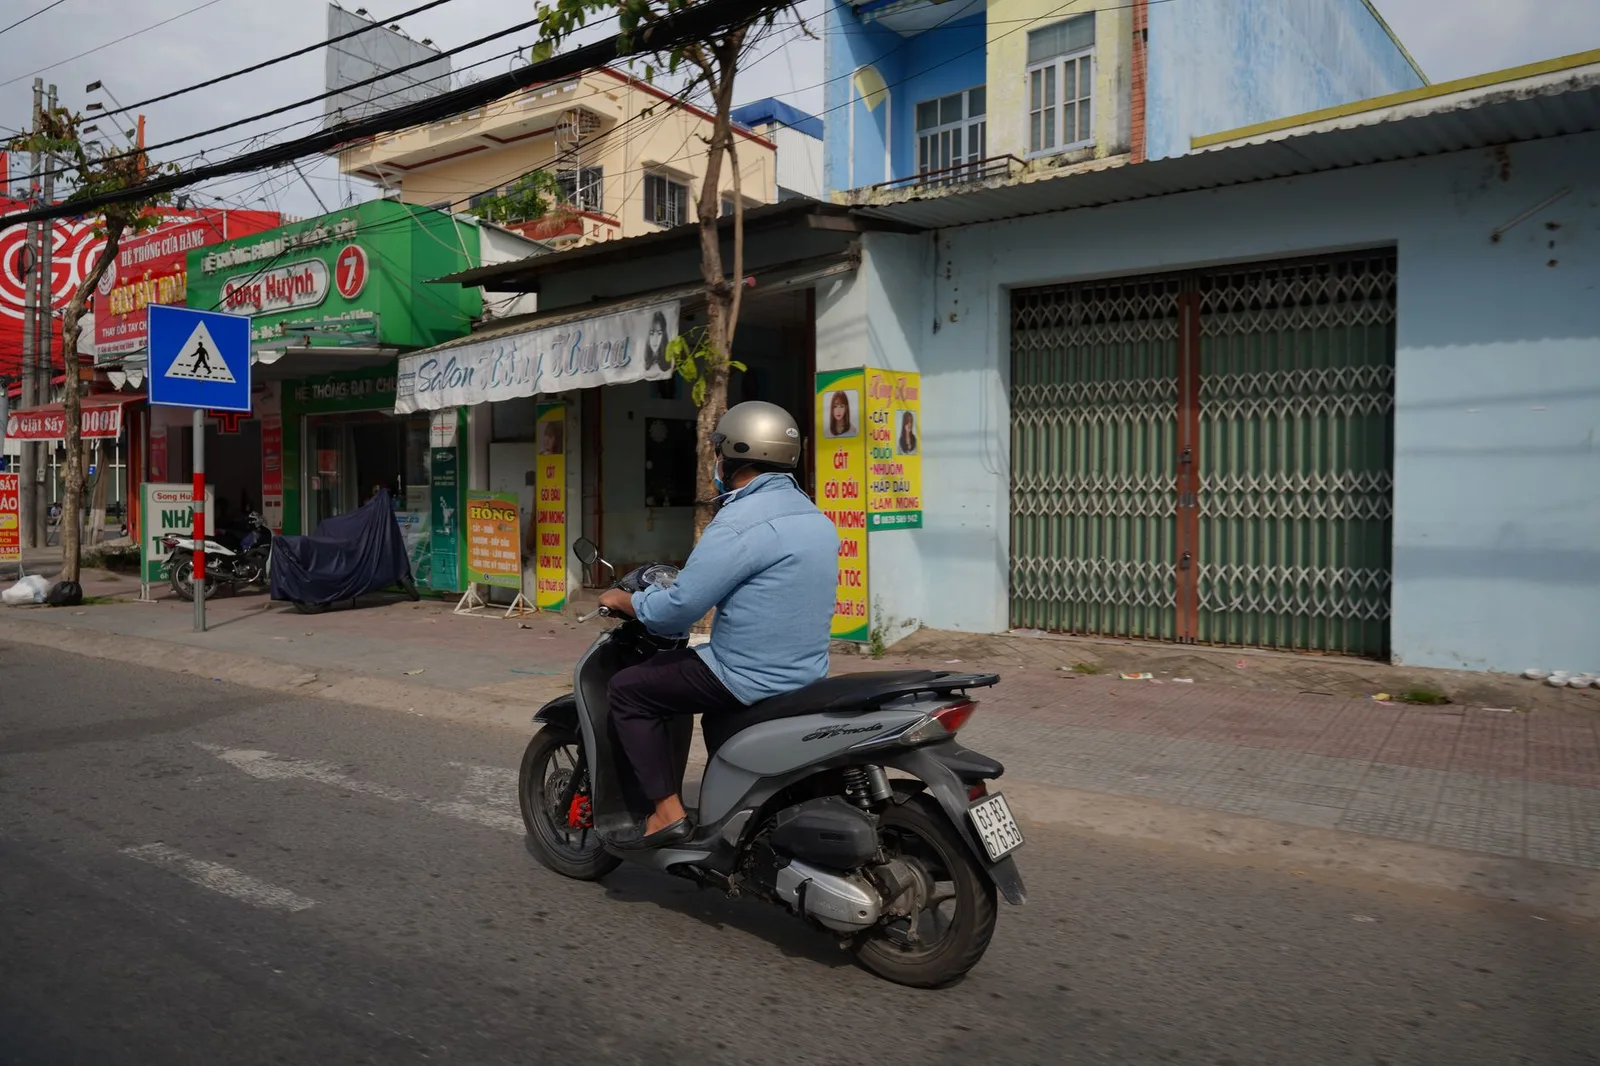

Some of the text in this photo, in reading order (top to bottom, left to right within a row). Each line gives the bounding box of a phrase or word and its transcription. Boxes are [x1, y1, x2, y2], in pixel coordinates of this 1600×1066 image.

[121, 247, 133, 268] HỆ
[133, 239, 161, 264] THỐNG
[179, 229, 204, 250] HÀNG
[344, 255, 357, 291] 7
[226, 266, 313, 310] Song Huỳnh
[102, 326, 116, 338] THAY
[127, 321, 138, 333] TAY
[418, 356, 475, 393] Salon
[20, 417, 42, 434] Giặt
[44, 416, 65, 434] Sấy
[873, 407, 890, 424] CẮT
[873, 426, 891, 441] UỐN
[833, 446, 849, 469] CẮT
[157, 492, 177, 502] Song
[839, 508, 865, 528] MÓNG
[845, 566, 861, 587] TÓC
[975, 798, 1007, 830] 63-B3
